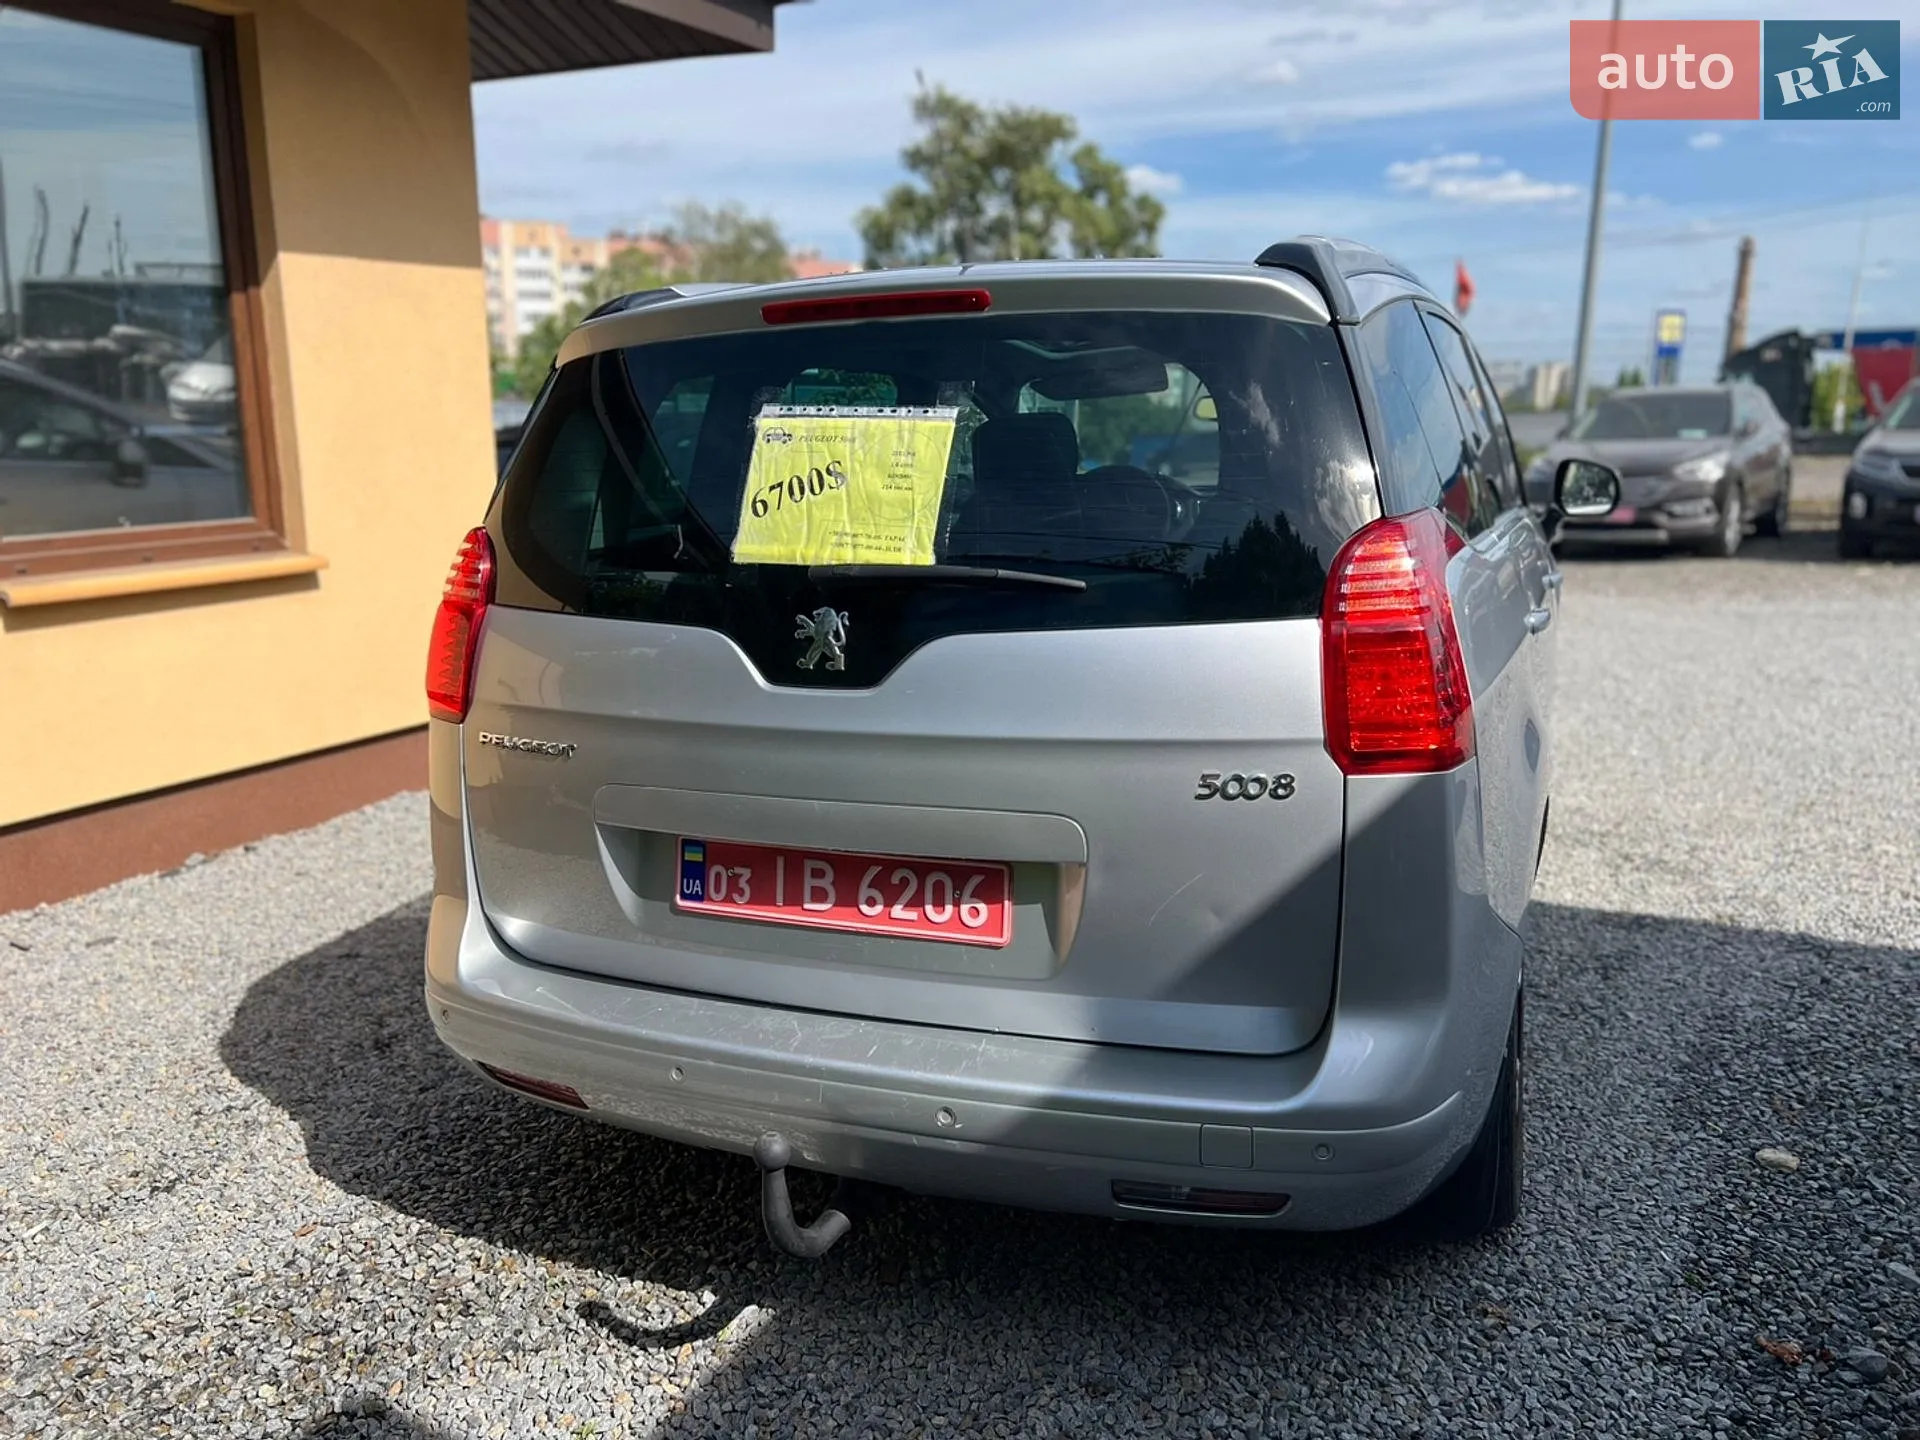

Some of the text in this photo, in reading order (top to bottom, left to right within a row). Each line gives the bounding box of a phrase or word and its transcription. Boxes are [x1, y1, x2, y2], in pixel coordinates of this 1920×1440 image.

[751, 460, 846, 518] 6700$
[479, 731, 577, 758] PEUGEOT
[1194, 772, 1296, 802] 5008
[683, 878, 702, 895] UA
[708, 864, 752, 904] 03
[858, 864, 989, 928] 6206
